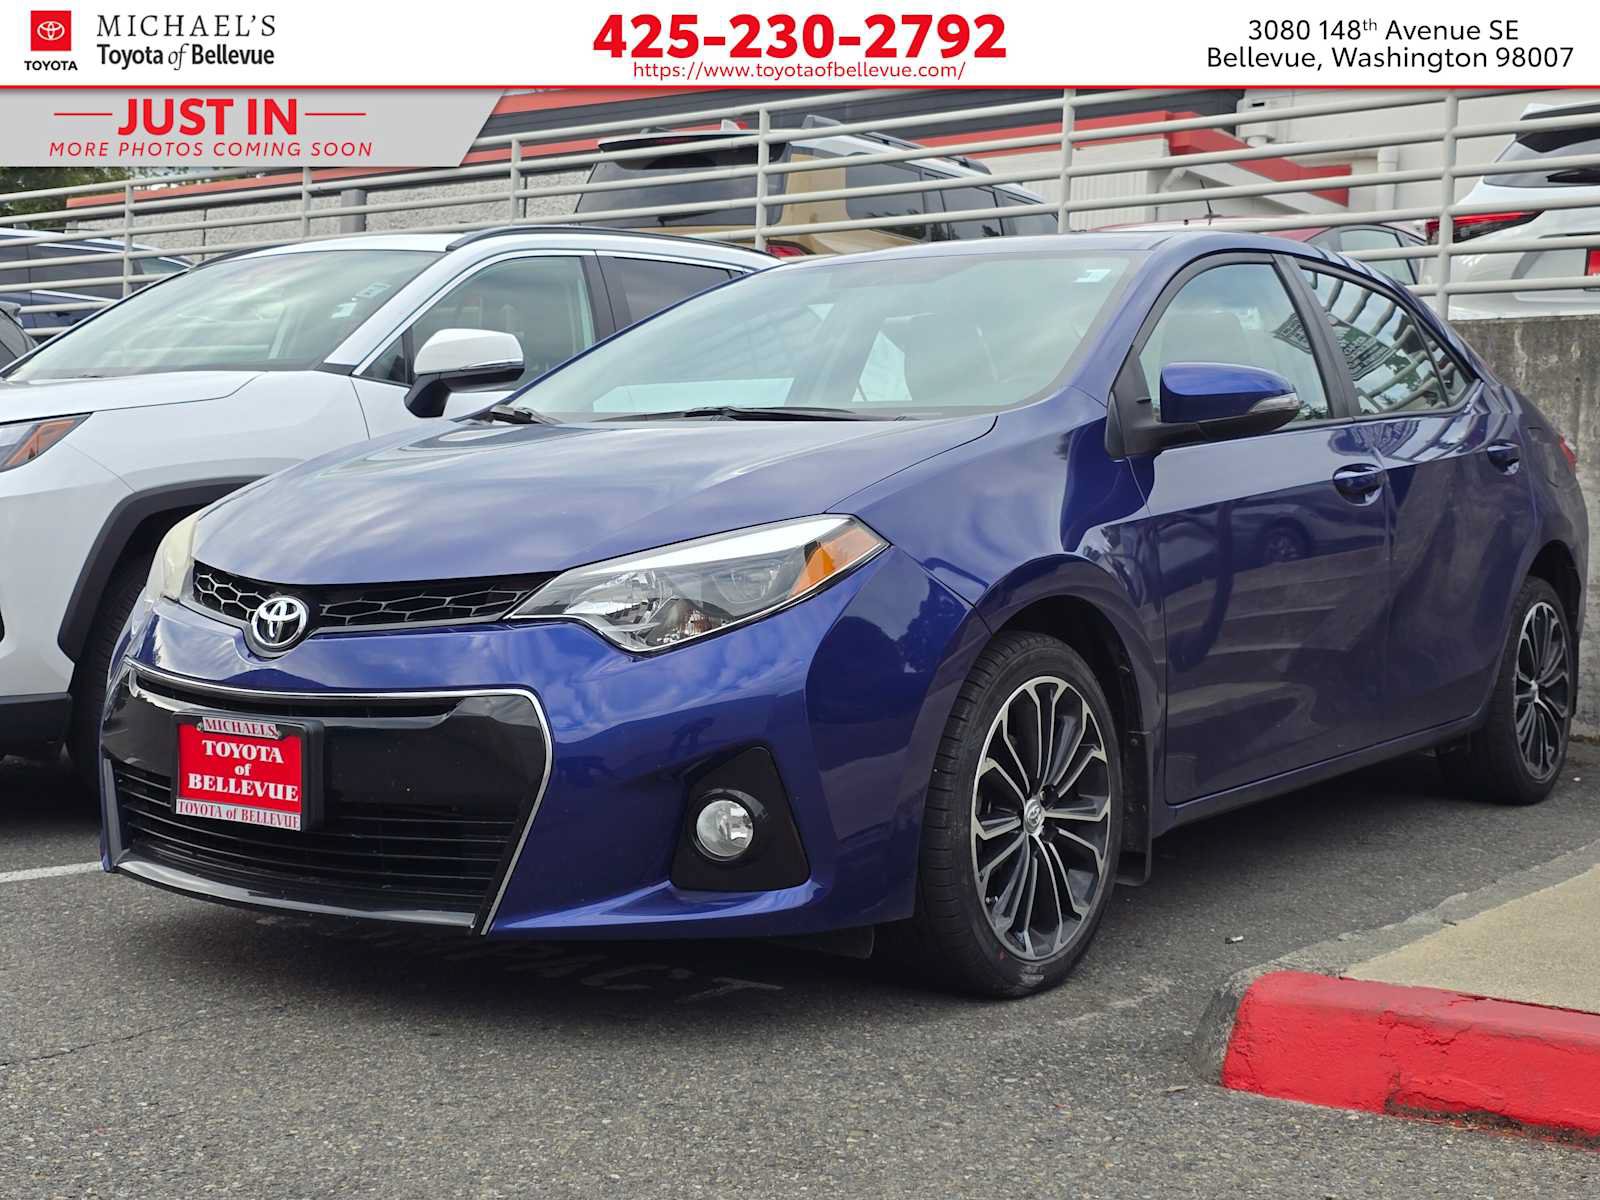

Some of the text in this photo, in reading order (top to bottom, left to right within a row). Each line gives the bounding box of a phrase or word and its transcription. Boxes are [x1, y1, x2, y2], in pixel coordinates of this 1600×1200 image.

[202, 740, 284, 763] TOYOTA
[234, 764, 251, 776] of
[188, 773, 299, 801] BELLEVUE
[178, 801, 299, 829] TOYOTA of BELLEVUE
